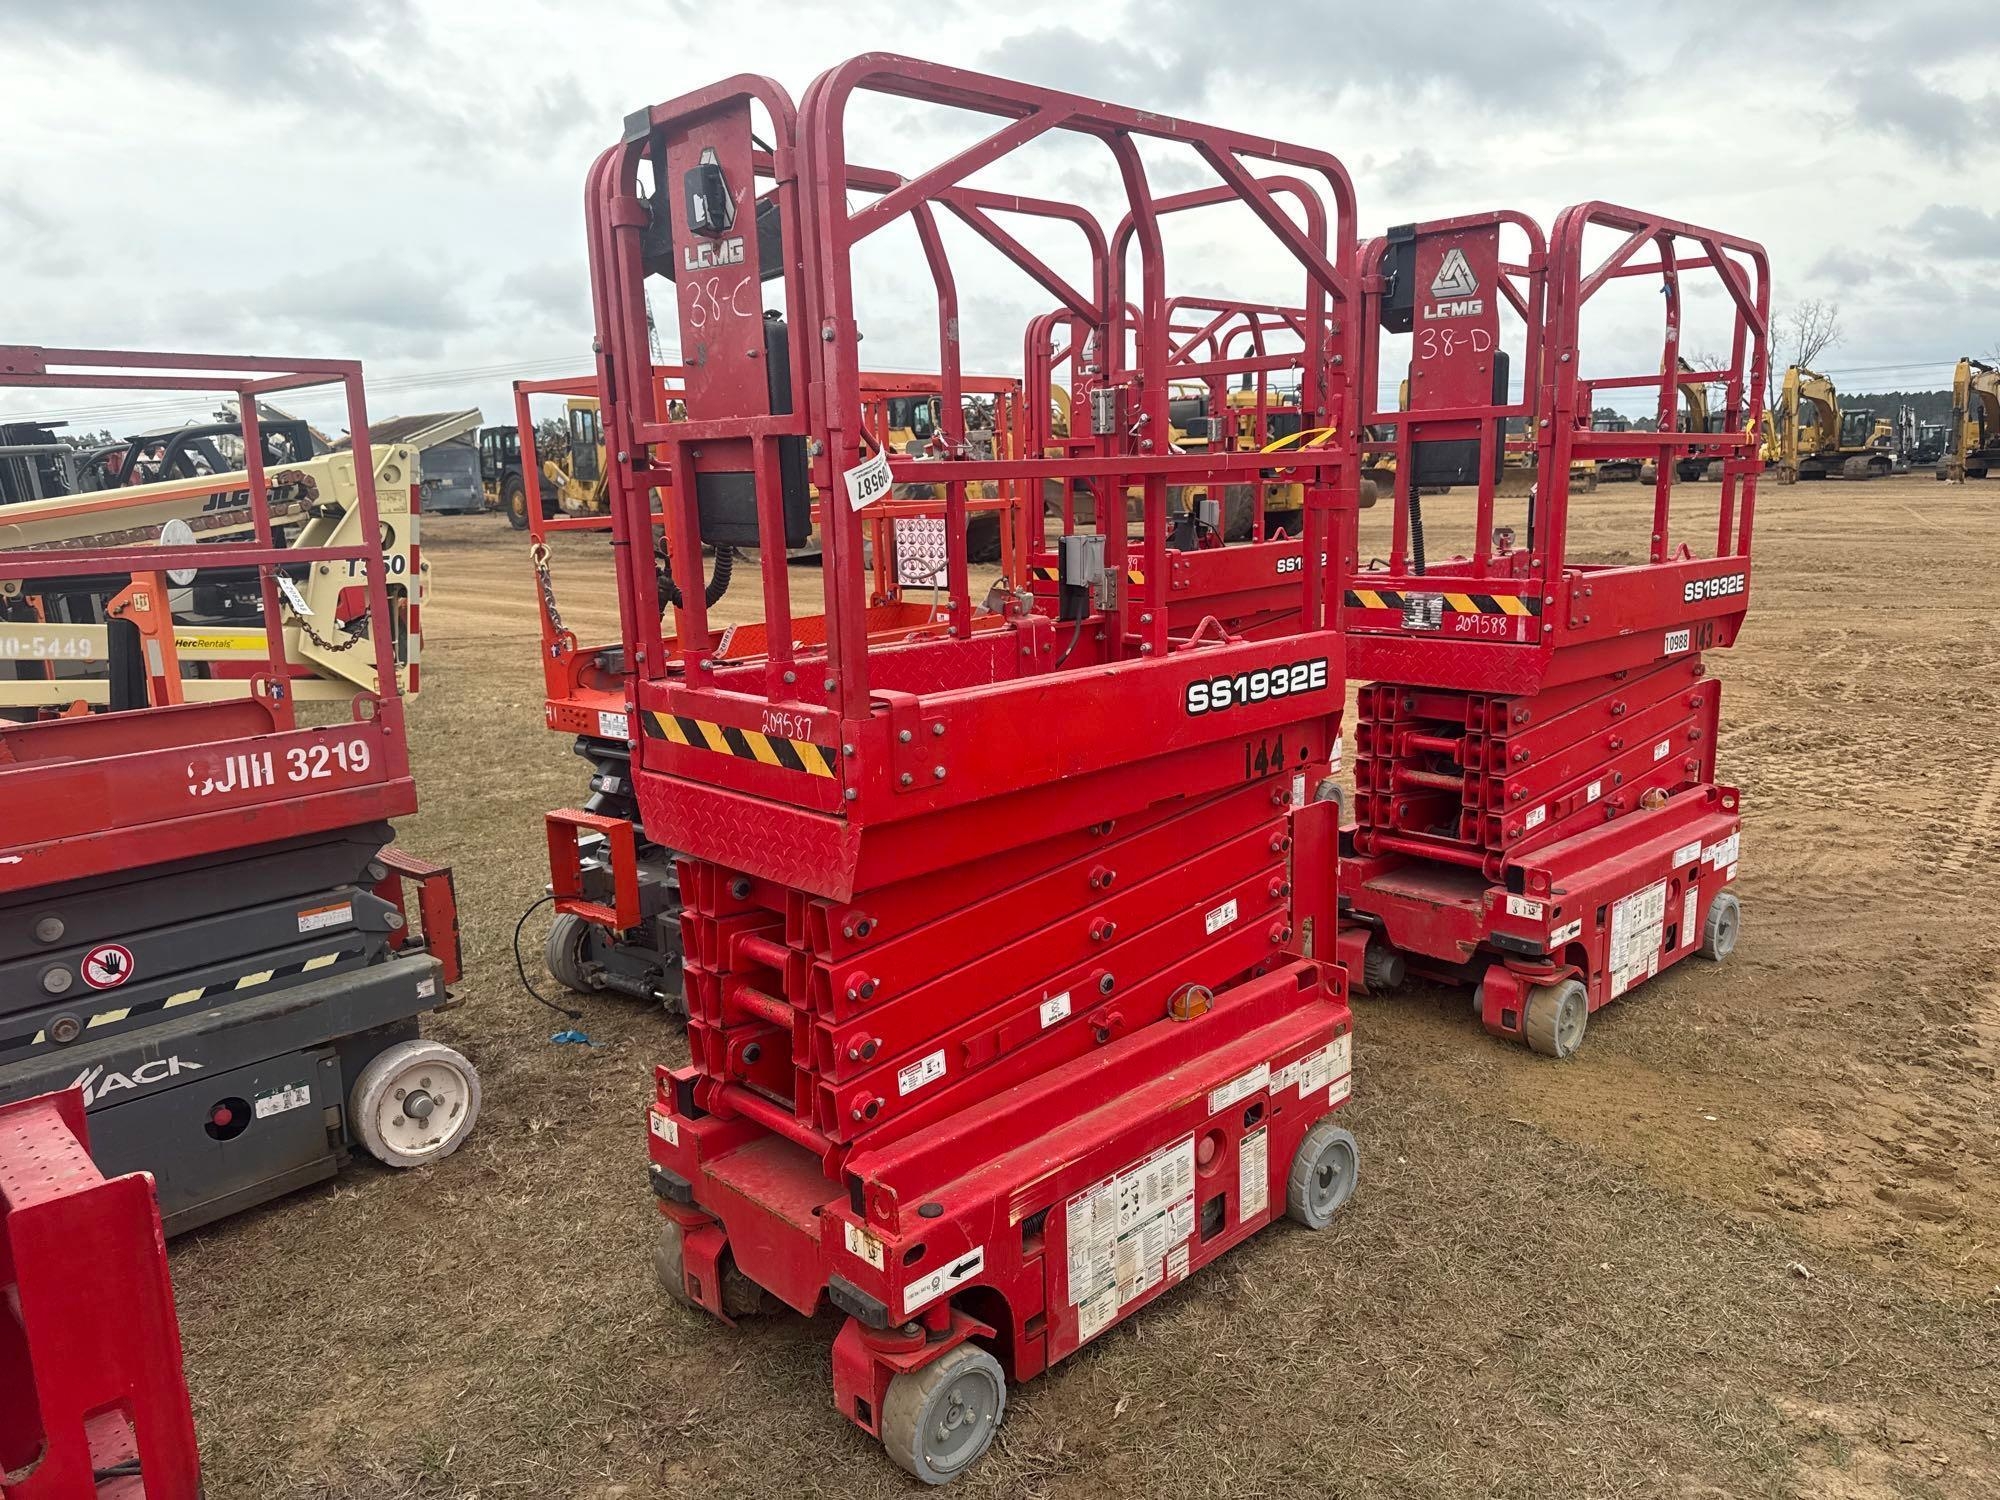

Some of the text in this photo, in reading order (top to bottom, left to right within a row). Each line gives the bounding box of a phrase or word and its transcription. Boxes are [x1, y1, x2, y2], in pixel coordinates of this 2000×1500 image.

[686, 276, 752, 327] 38-C
[1419, 328, 1491, 359] 38-D
[857, 463, 889, 500] 09587
[202, 491, 250, 511] JLG
[1684, 574, 1745, 602] SS1932E
[1456, 614, 1507, 636] 209588
[1665, 633, 1688, 652] 10988
[1187, 659, 1328, 714] SS1932E
[762, 709, 811, 742] 209587
[286, 740, 371, 782] 3219
[1246, 733, 1285, 780] 144
